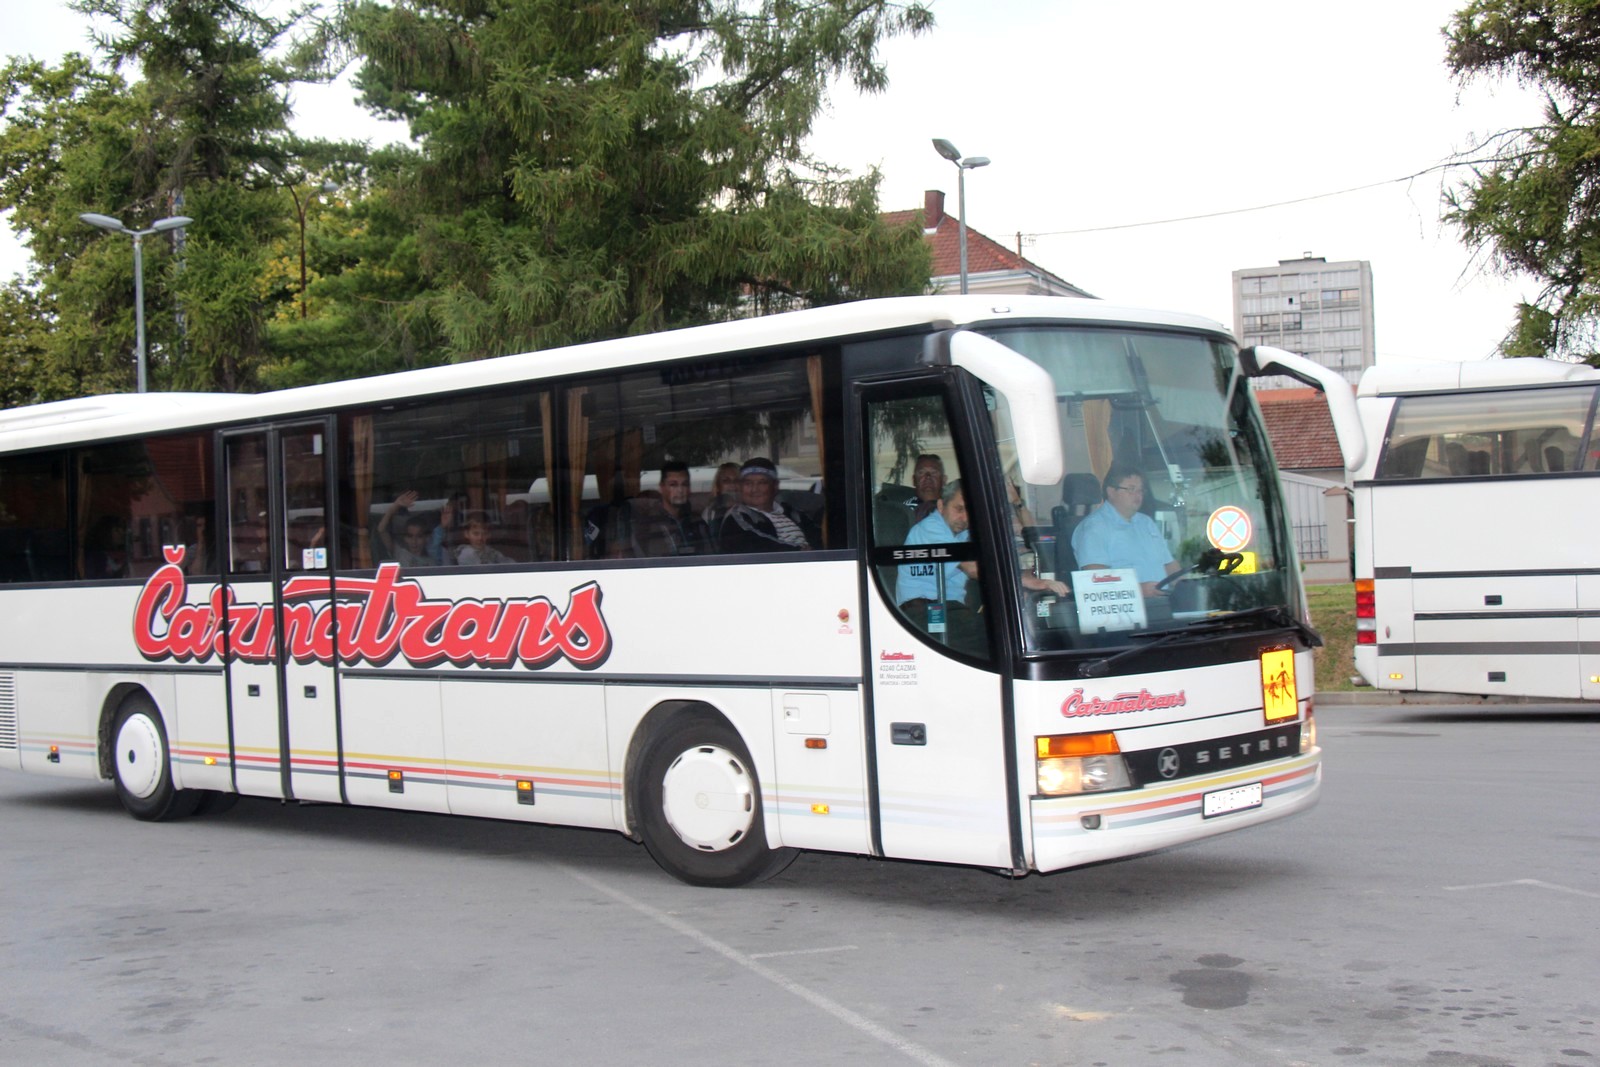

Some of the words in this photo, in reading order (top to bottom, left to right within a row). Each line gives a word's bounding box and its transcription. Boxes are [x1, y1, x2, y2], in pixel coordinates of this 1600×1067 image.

[910, 564, 935, 577] ULAZ
[1083, 589, 1136, 603] POVREMENI
[1091, 603, 1135, 616] PRIJEVOZ
[1060, 687, 1187, 718] Čazmatrans
[1196, 735, 1289, 764] SETRA
